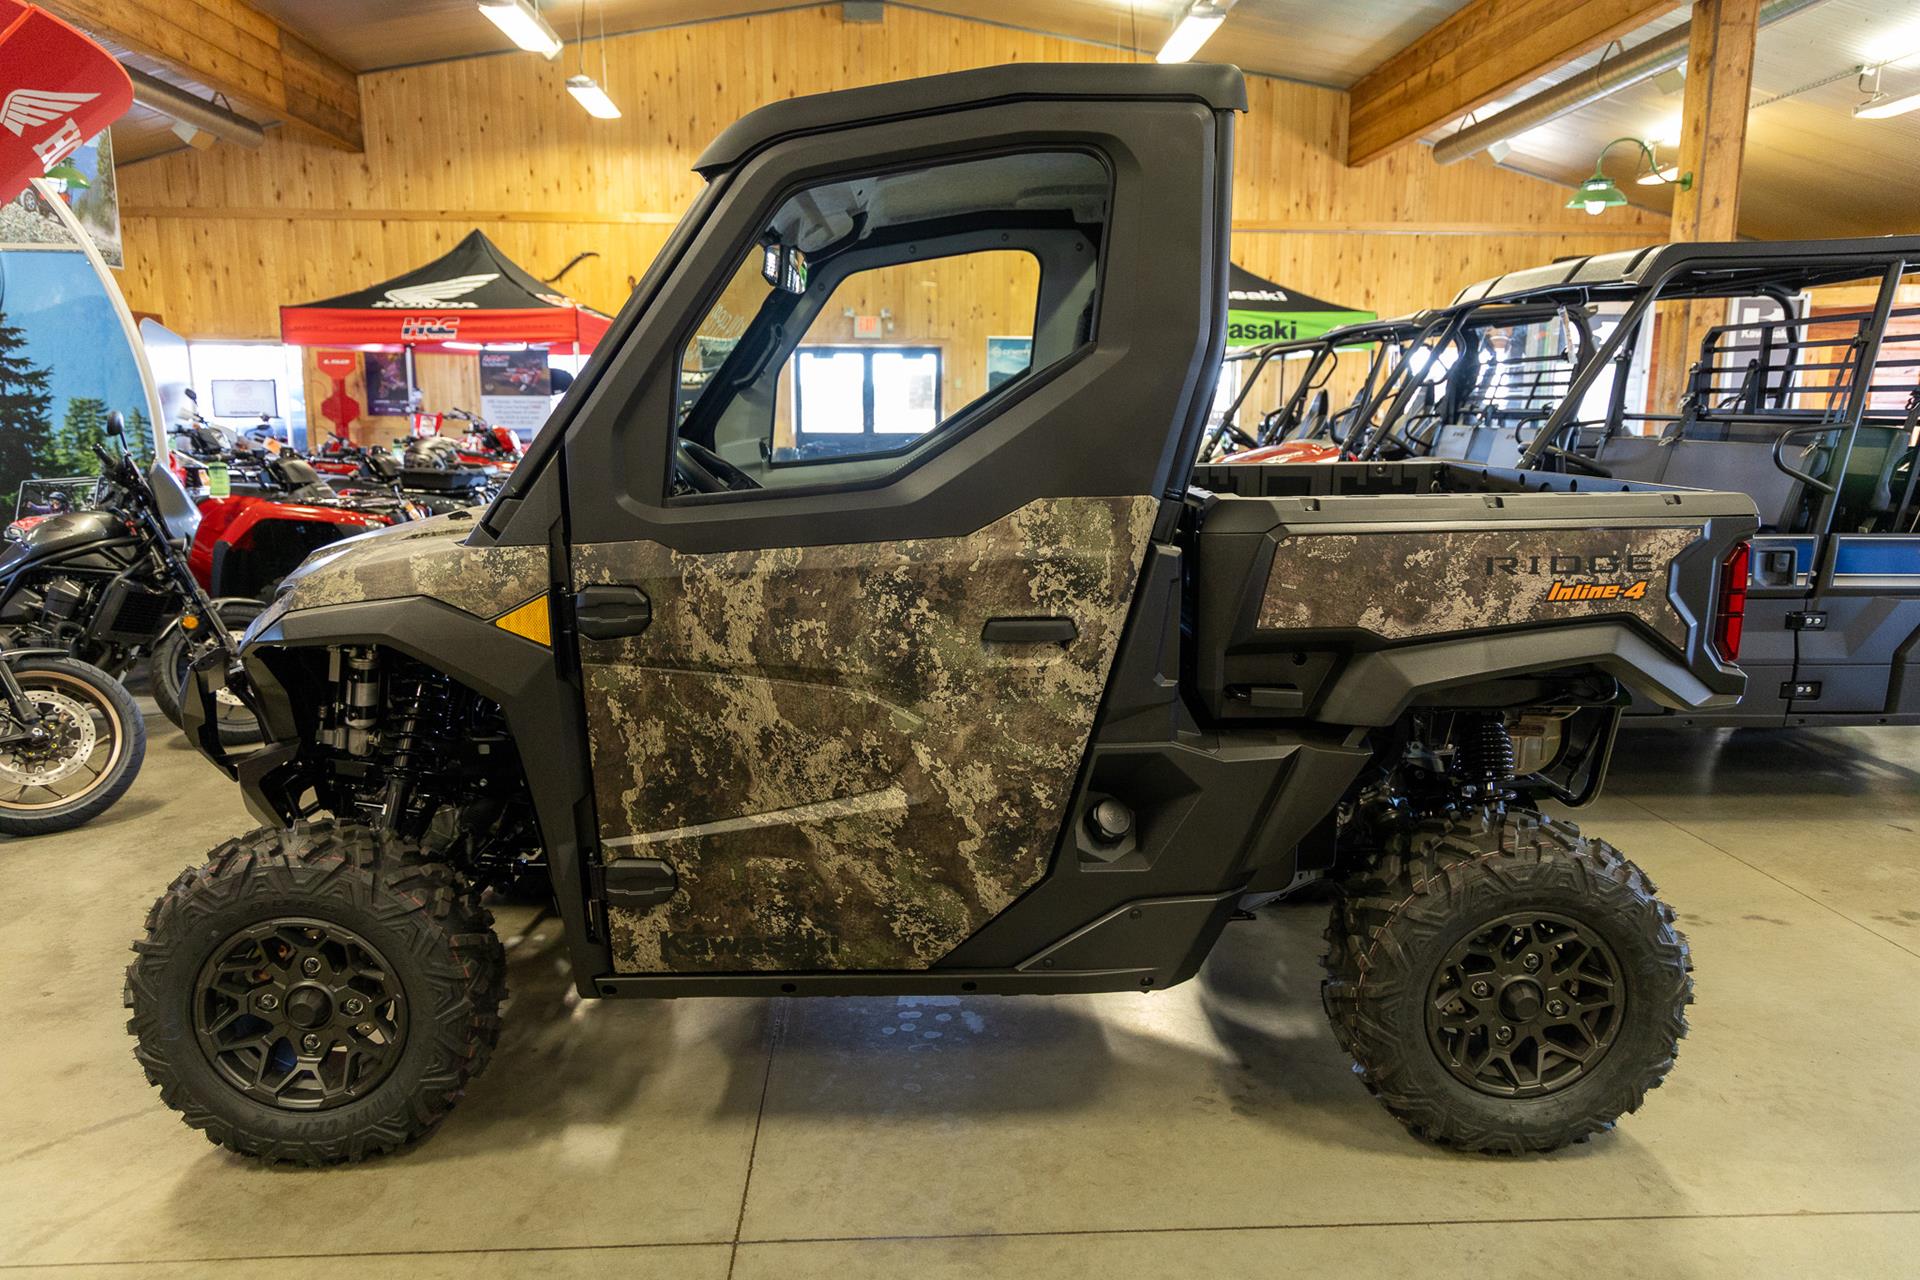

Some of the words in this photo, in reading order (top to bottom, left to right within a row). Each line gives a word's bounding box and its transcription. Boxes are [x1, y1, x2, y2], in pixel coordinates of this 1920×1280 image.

[402, 317, 460, 337] HRC
[1486, 554, 1655, 575] RIDGE
[1547, 579, 1649, 602] Inline-4
